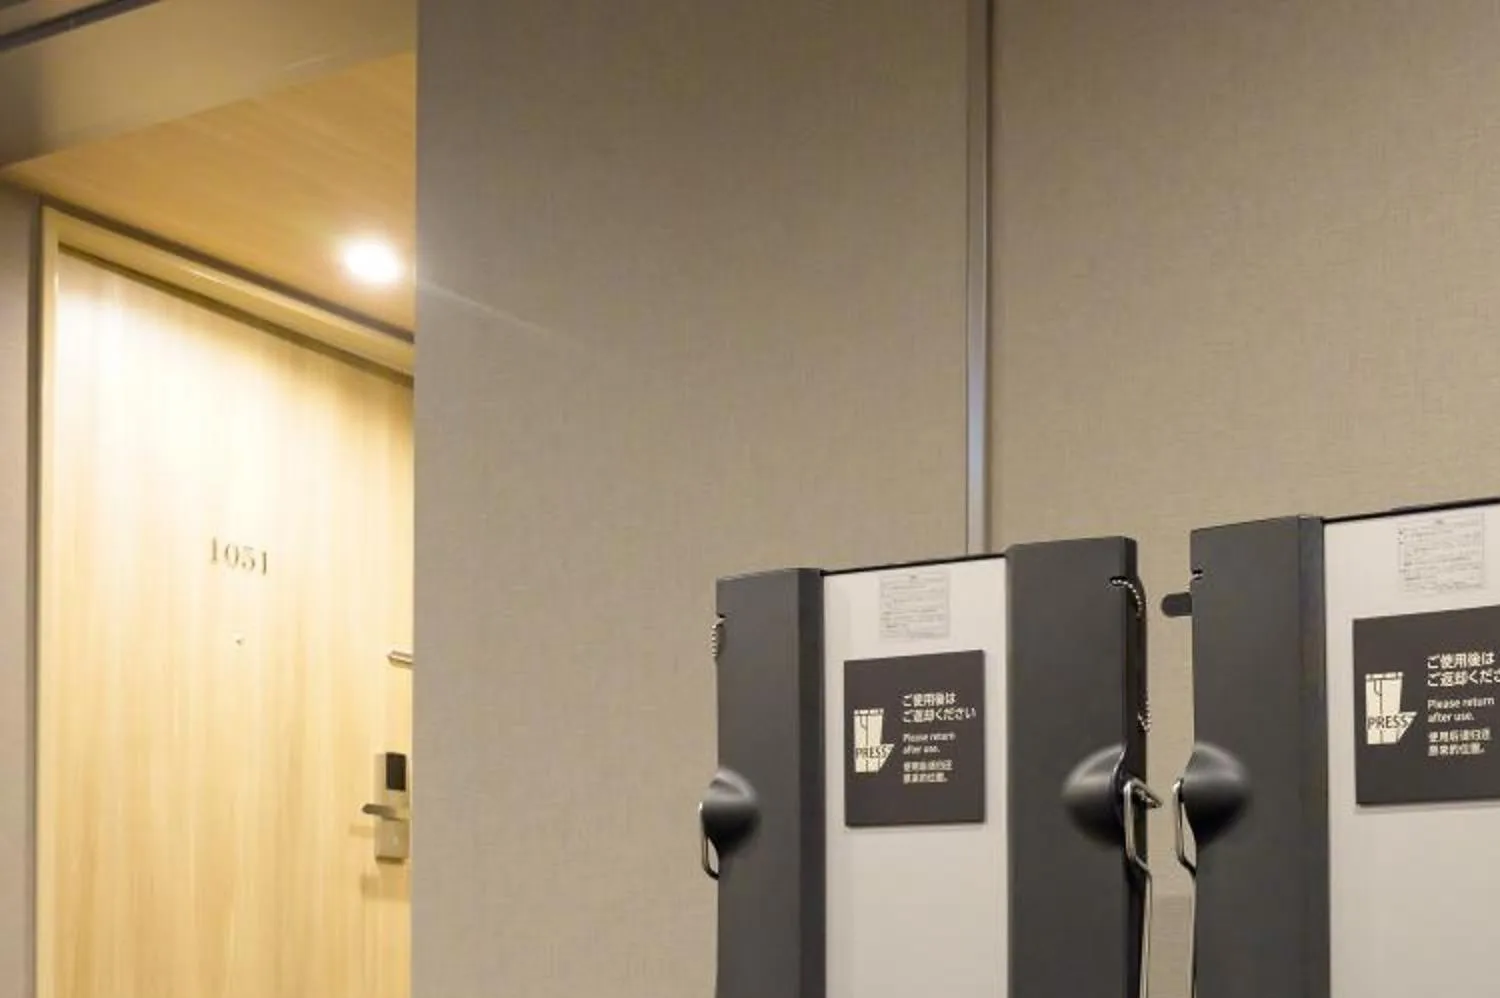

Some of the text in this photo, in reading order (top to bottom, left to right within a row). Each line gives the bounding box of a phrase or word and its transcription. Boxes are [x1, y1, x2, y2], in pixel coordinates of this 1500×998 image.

[210, 536, 268, 577] 1051
[1427, 652, 1495, 669] ご使用後は
[1427, 697, 1495, 710] Please return
[1367, 715, 1409, 729] PRESS
[1427, 712, 1452, 723] after
[856, 747, 890, 759] PRESS
